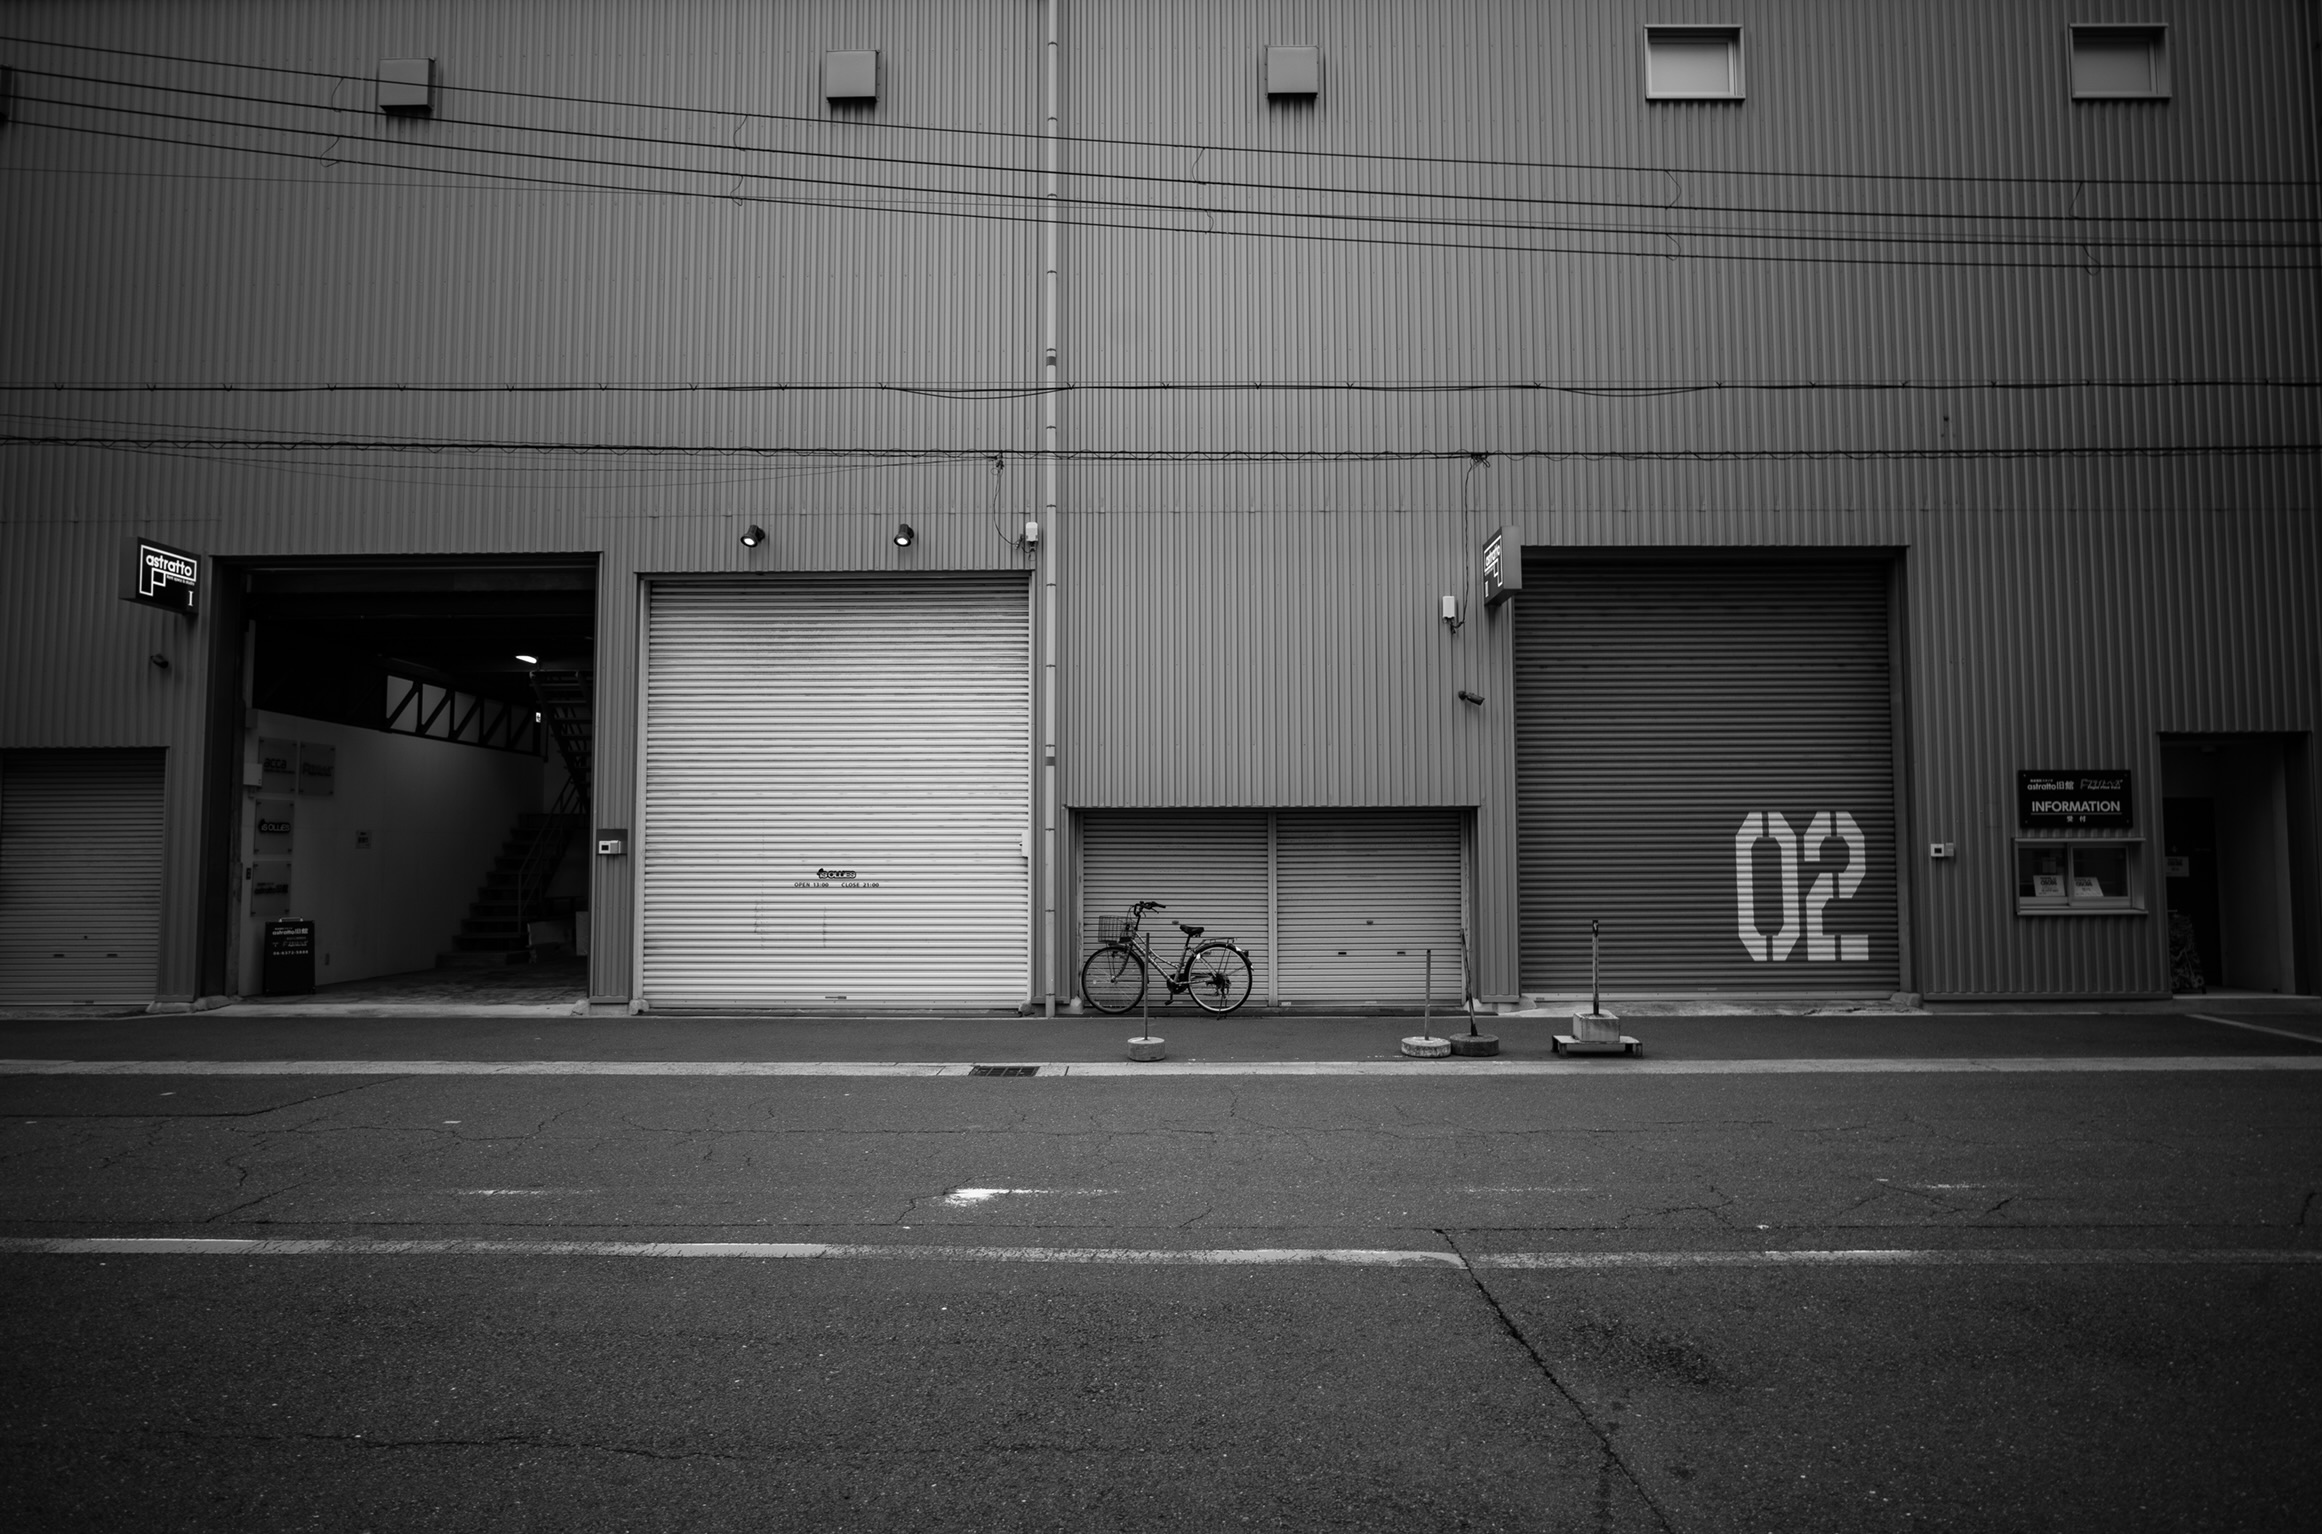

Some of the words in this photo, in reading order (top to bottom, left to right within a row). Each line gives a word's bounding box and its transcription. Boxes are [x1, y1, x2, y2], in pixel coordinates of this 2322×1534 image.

[145, 554, 192, 577] astratto
[187, 590, 194, 607] I
[264, 758, 286, 769] acca
[2032, 800, 2120, 812] INFORMATION
[1735, 811, 1869, 962] 02
